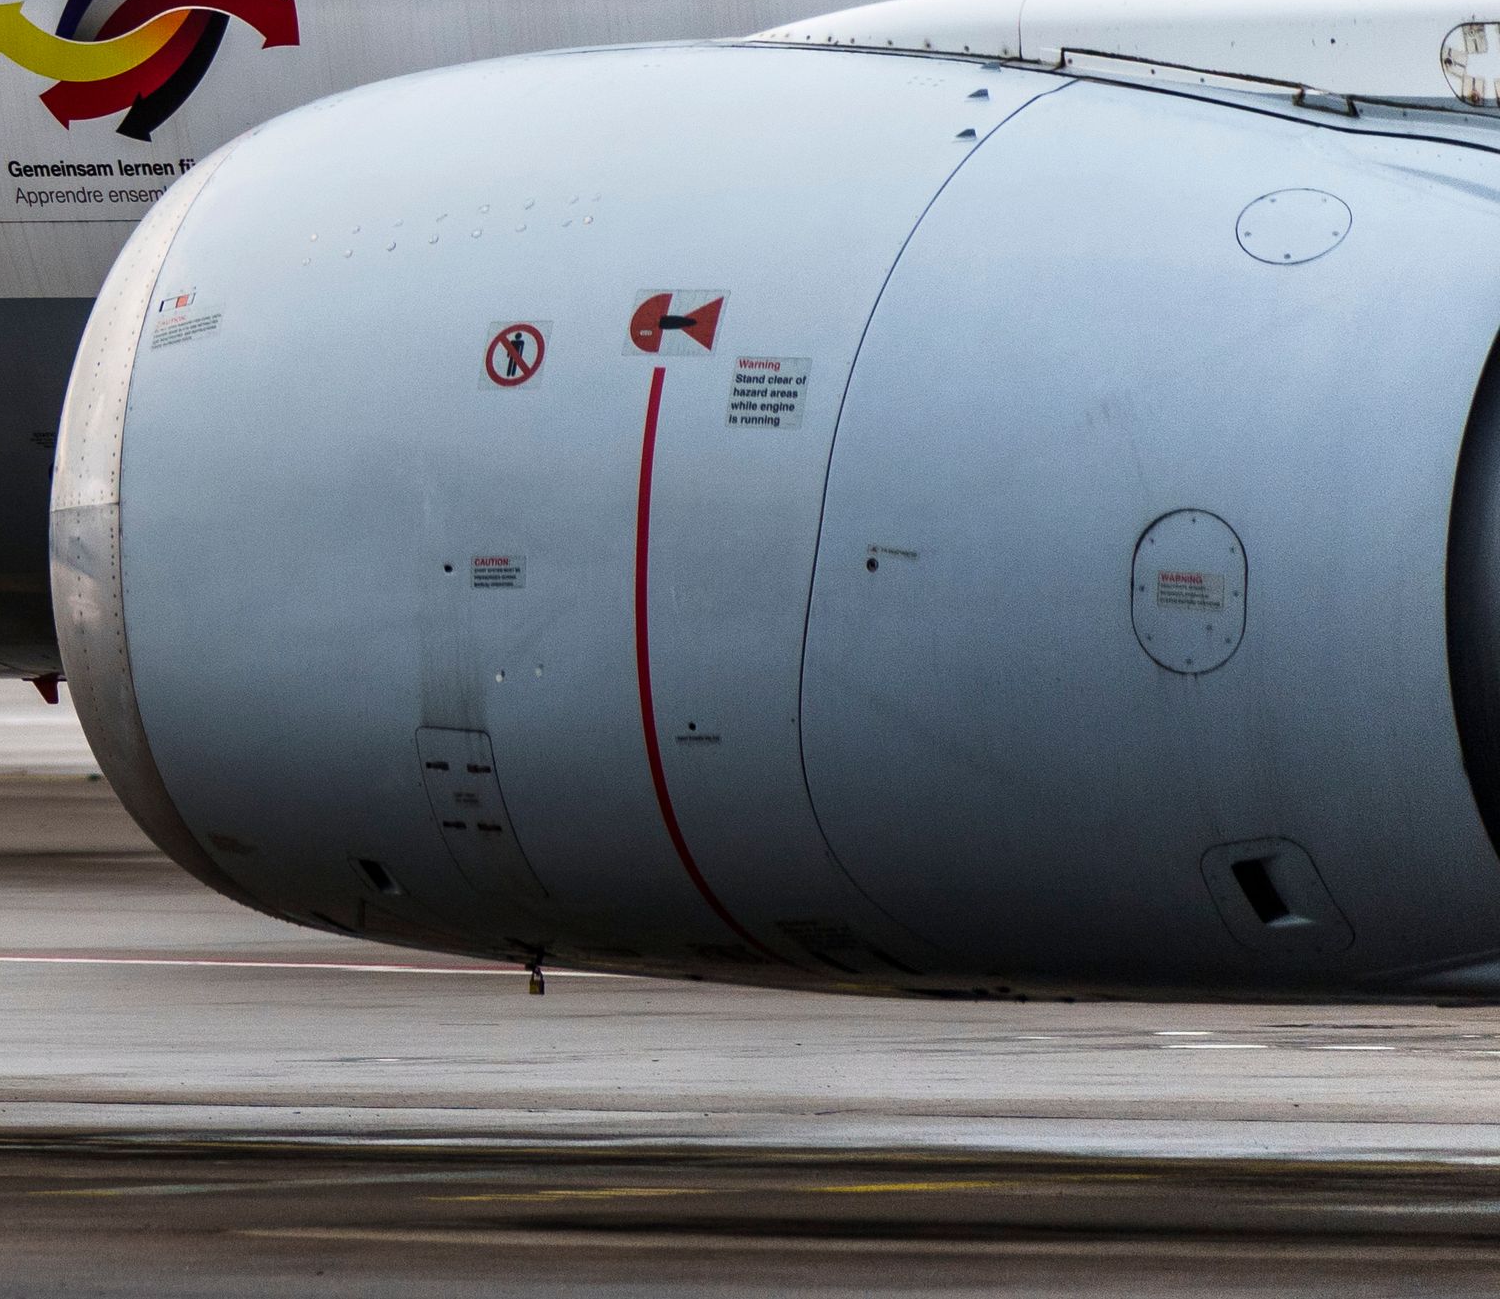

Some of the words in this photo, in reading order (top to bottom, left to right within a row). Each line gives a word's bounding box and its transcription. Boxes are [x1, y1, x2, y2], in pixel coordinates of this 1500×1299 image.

[7, 160, 114, 178] Gemeinsam
[117, 159, 175, 176] lernen
[178, 158, 196, 175] fü
[15, 186, 104, 208] Apprendre
[108, 186, 167, 203] ensem
[739, 358, 781, 371] Warning
[735, 373, 765, 384] Stand
[768, 375, 793, 385] clear
[795, 375, 807, 385] of
[733, 387, 768, 398] hazard
[770, 390, 798, 399] areas
[731, 401, 758, 411] while
[760, 402, 795, 414] engine
[728, 414, 738, 424] is
[740, 415, 780, 427] running
